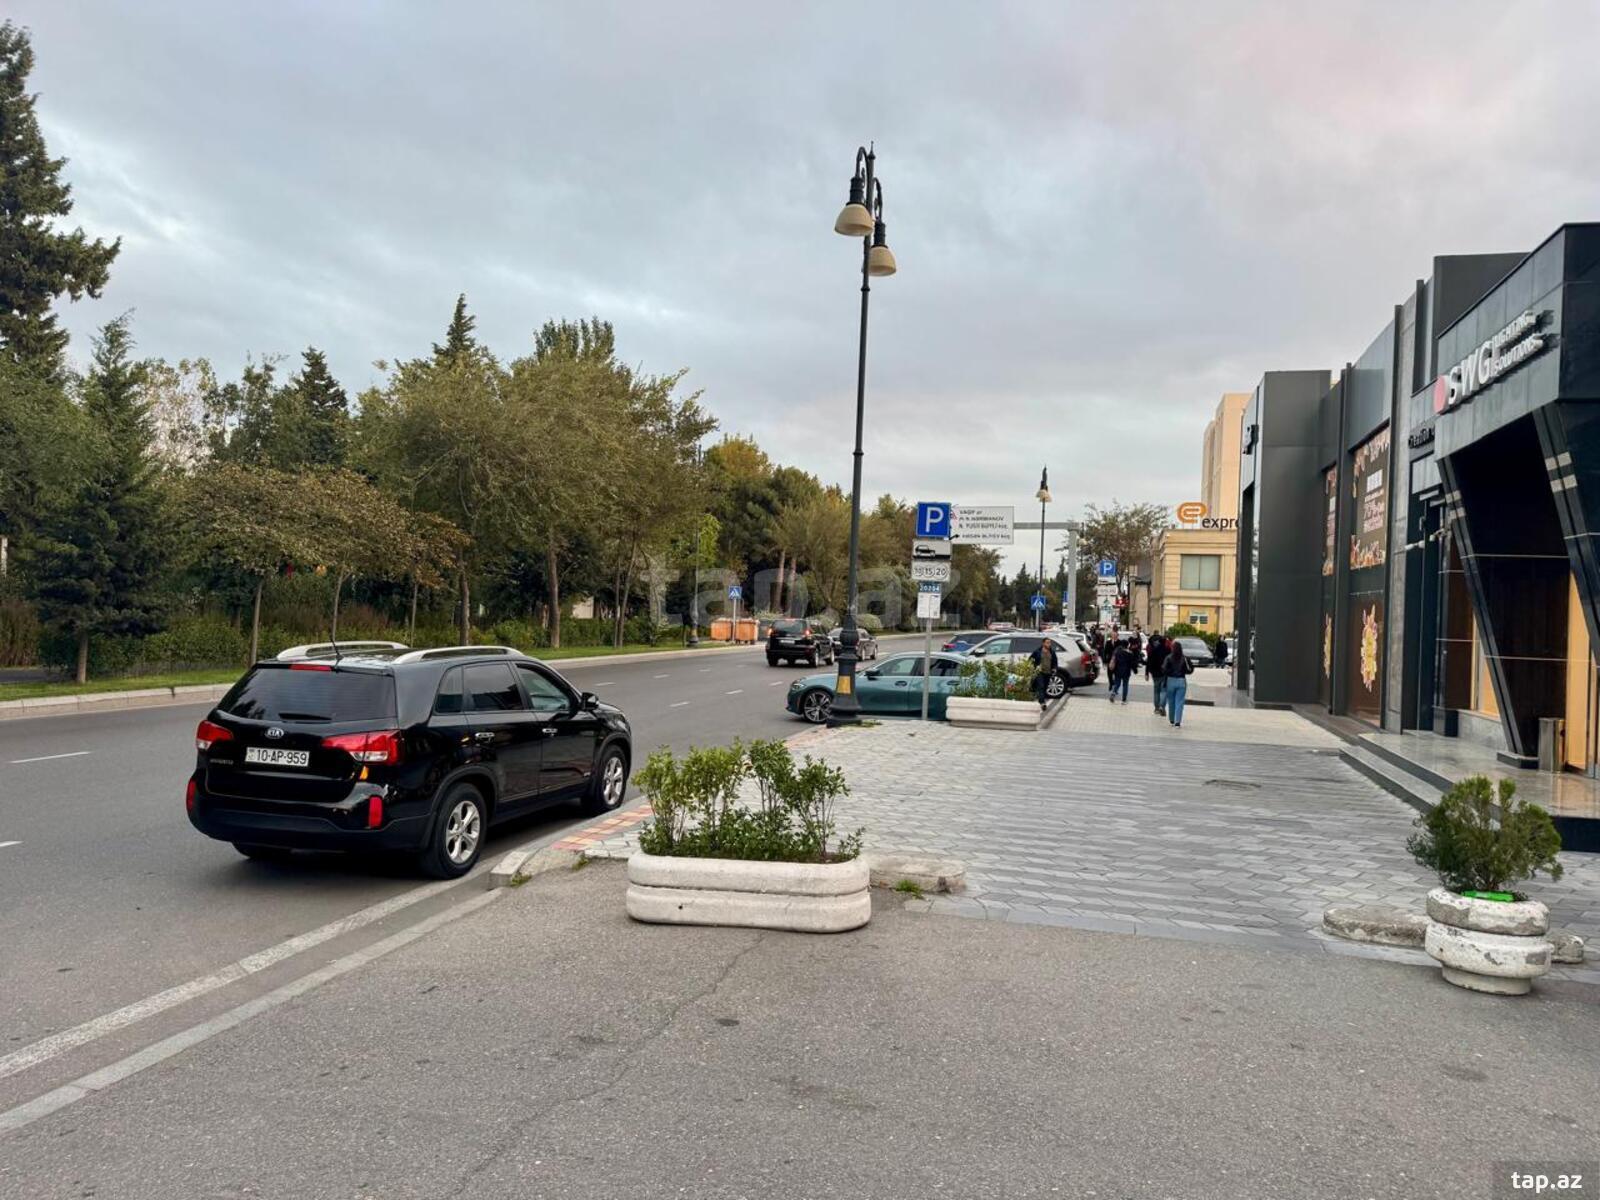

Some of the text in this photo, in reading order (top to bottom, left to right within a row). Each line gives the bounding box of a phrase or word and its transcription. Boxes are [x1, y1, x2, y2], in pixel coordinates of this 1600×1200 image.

[1448, 340, 1492, 404] SWG
[926, 506, 944, 533] P
[1103, 563, 1113, 575] P
[257, 749, 308, 765] 10-AP-959
